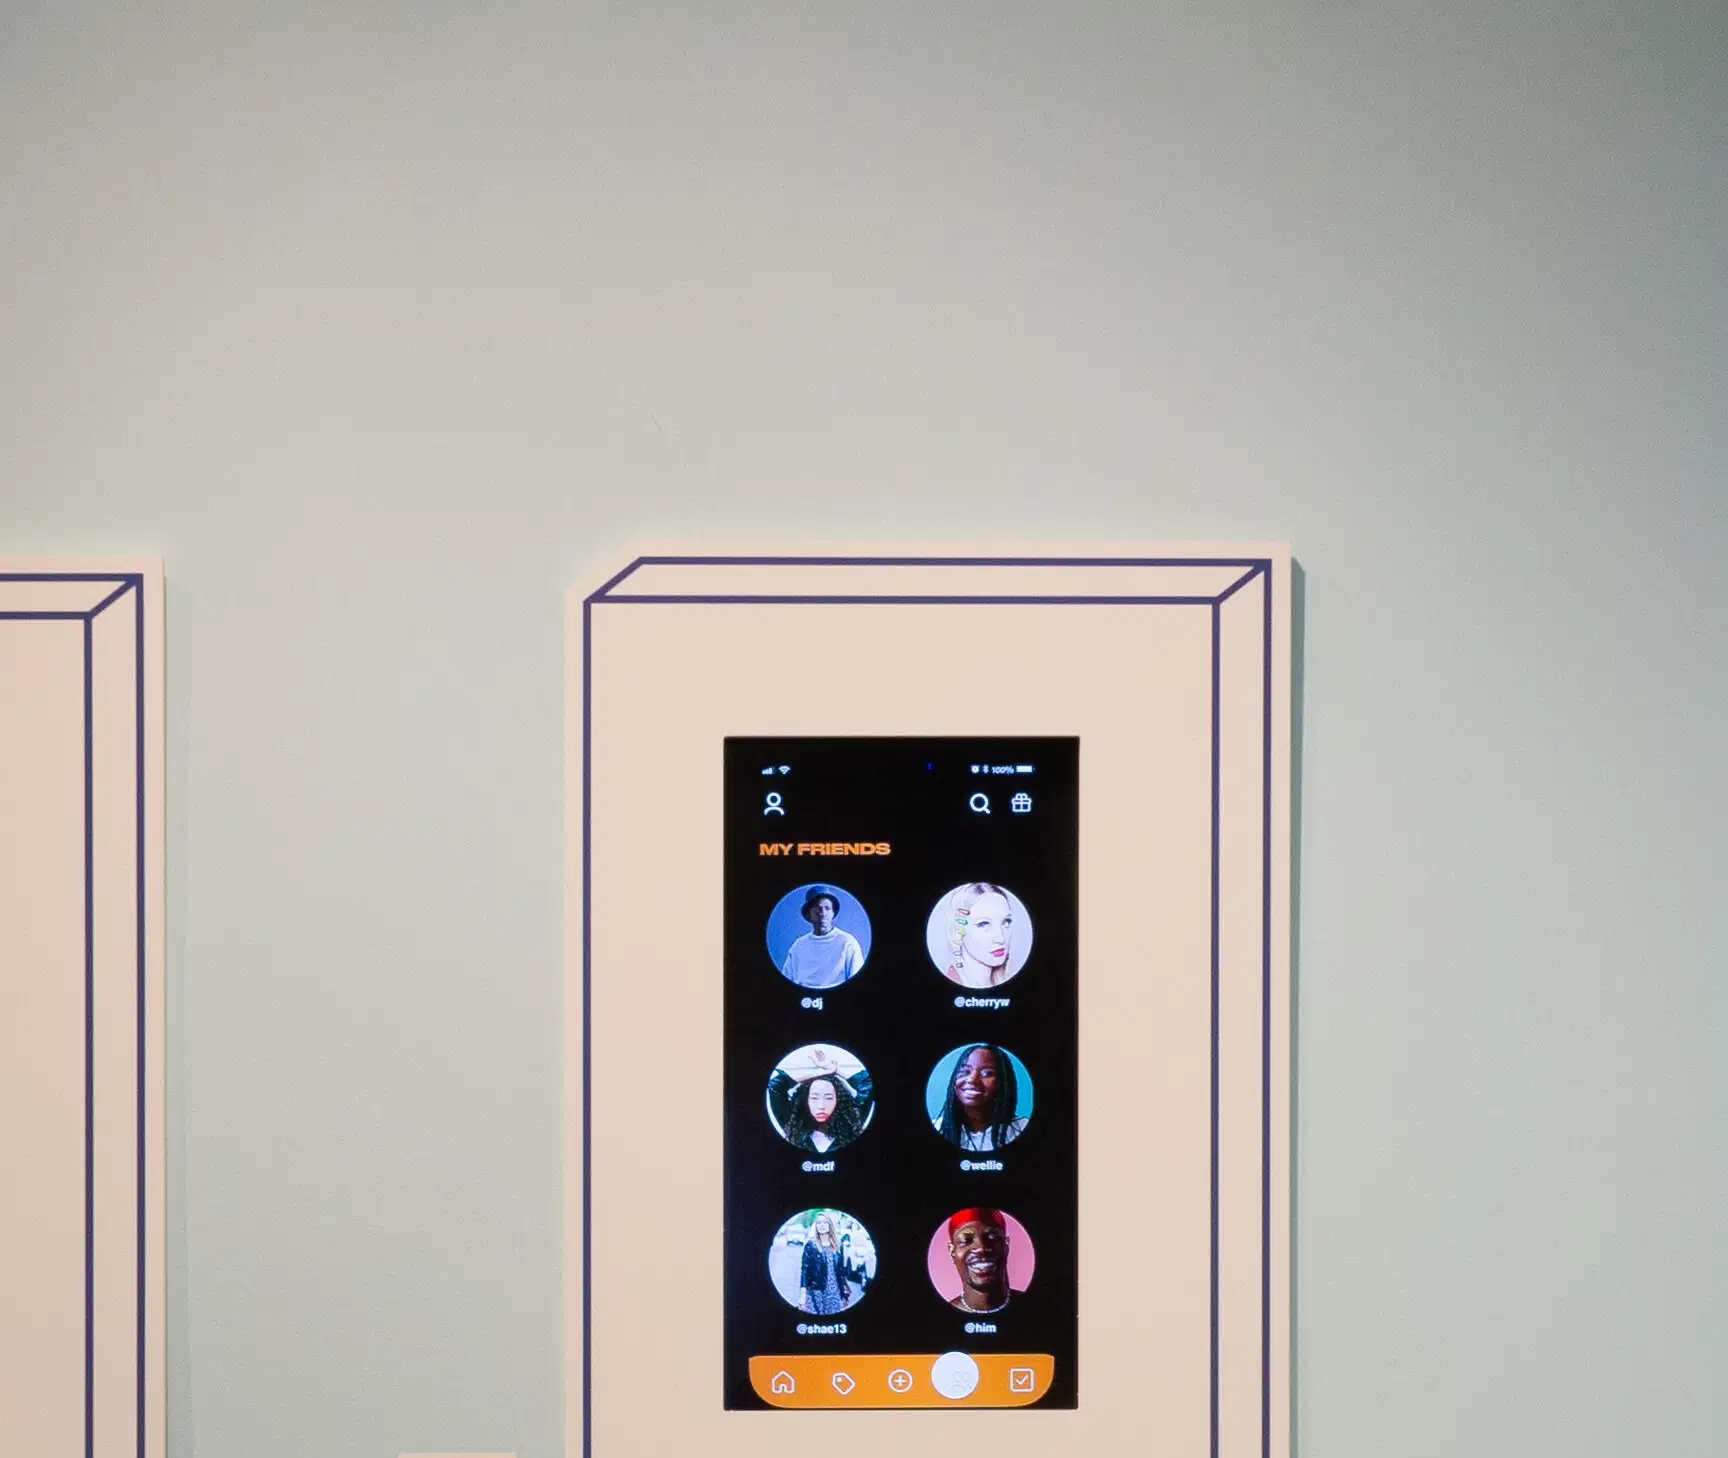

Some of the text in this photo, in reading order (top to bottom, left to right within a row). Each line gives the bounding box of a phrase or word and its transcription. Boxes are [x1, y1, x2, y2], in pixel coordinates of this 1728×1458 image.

[759, 842, 892, 856] MY FRIENDS
[801, 997, 824, 1011] @dj
[954, 996, 1011, 1010] @cherryw
[801, 1160, 835, 1173] @mdf
[796, 1322, 847, 1335] @shae13
[964, 1321, 997, 1334] @him
